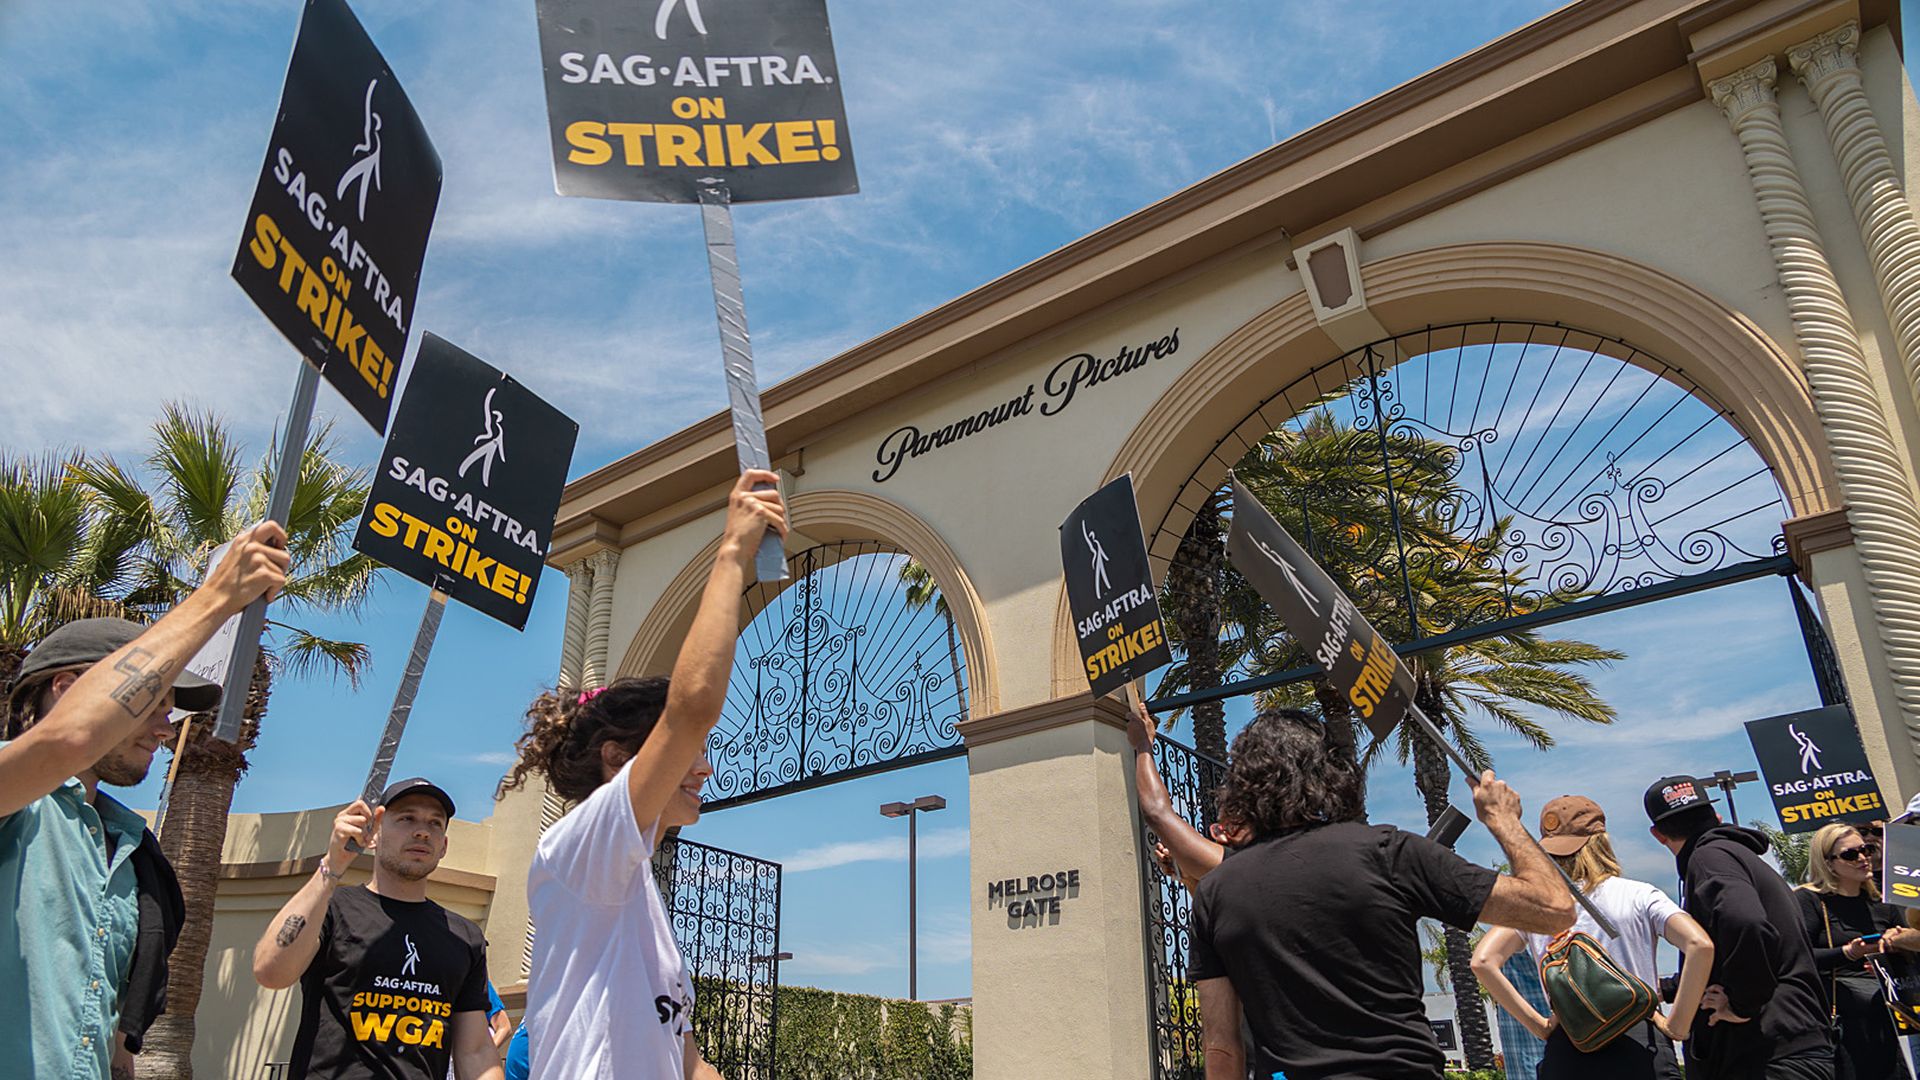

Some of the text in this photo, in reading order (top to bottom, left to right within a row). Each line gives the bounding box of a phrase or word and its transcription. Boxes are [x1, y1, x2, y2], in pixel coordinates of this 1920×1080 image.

[671, 96, 725, 119] ON
[565, 120, 841, 167] STRIKE!
[321, 256, 351, 300] ON
[250, 213, 394, 399] STRIKE!
[872, 327, 1179, 483] Paramount Pictures
[446, 517, 478, 543] ON
[368, 502, 532, 605] STRIKE!
[1108, 622, 1124, 640] ON
[1086, 620, 1163, 681] STRIKE!
[1350, 640, 1365, 662] ON
[1781, 792, 1881, 823] STRIKE!
[1814, 790, 1835, 800] ON
[988, 869, 1080, 899] MELROSE
[1007, 896, 1061, 918] GATE
[352, 992, 451, 1017] SUPPORTS
[350, 1011, 445, 1049] WGA
